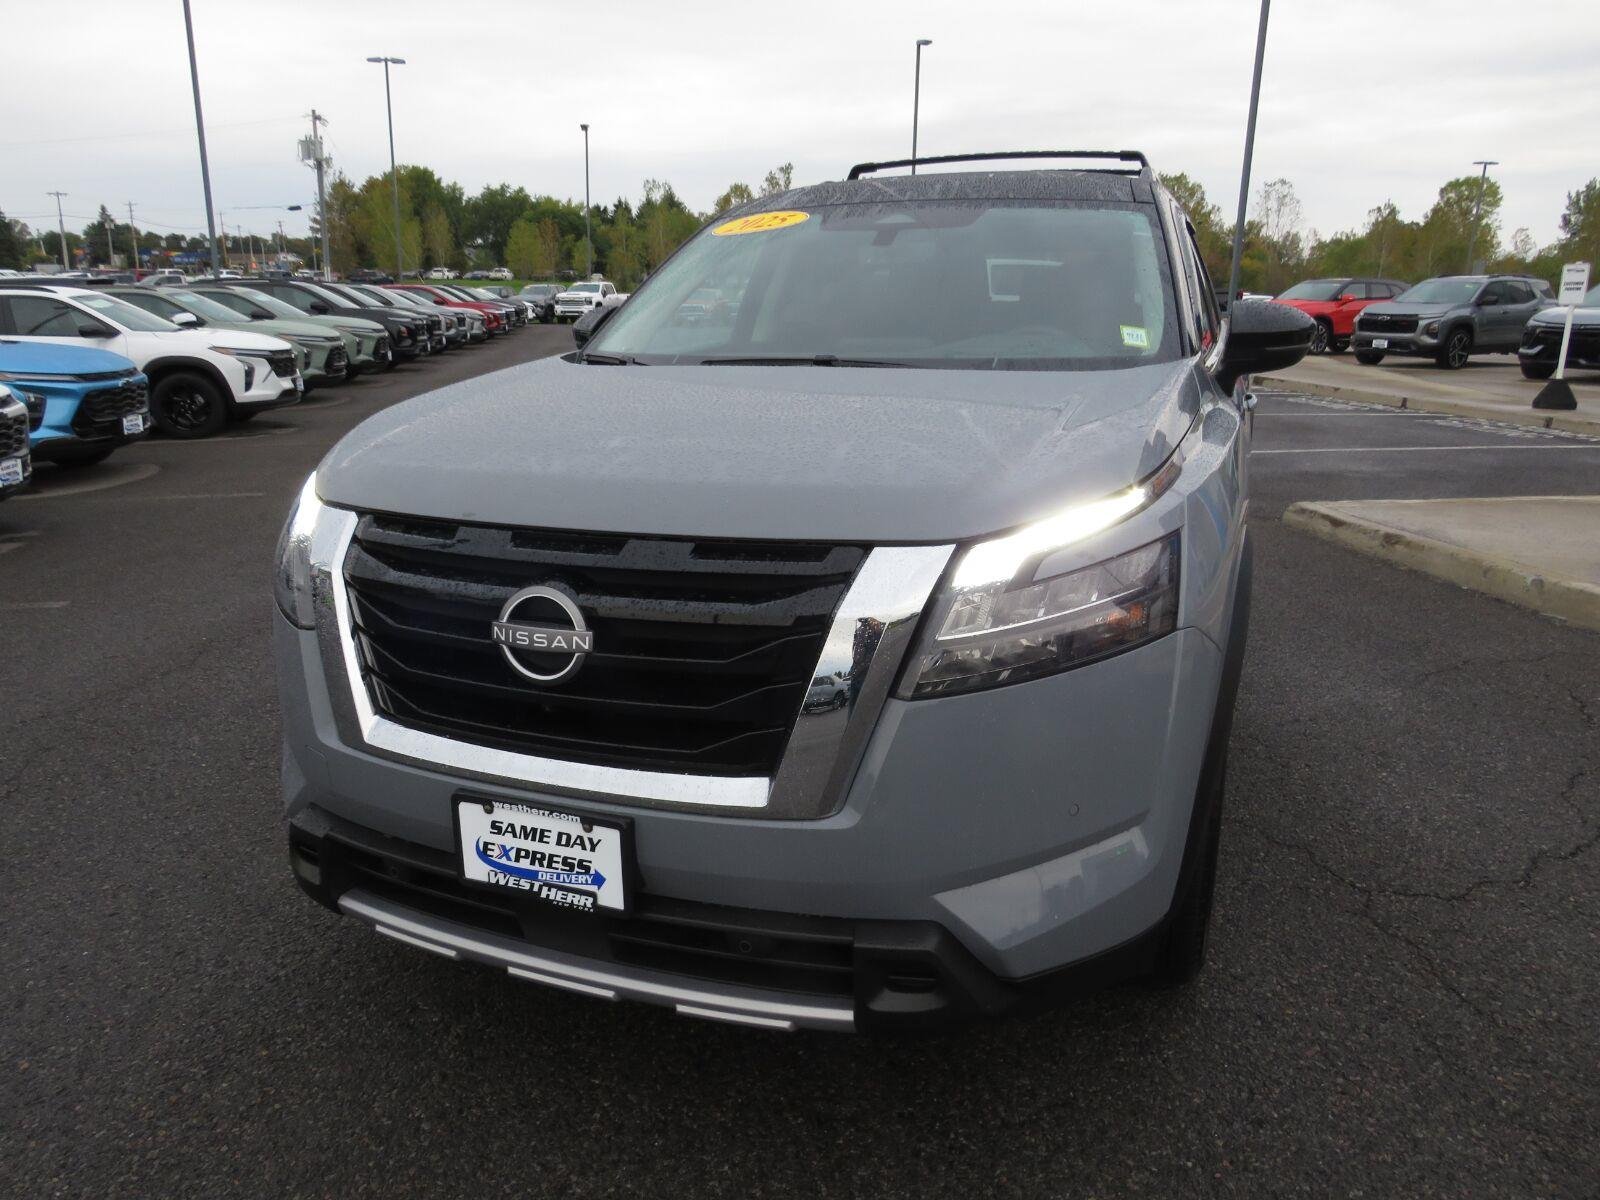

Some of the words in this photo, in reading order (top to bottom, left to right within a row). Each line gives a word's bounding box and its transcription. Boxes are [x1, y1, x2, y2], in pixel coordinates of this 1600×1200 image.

[493, 626, 589, 650] NISSAN
[493, 801, 581, 823] westherr.com
[489, 819, 552, 844] SAME
[555, 831, 602, 852] DAY
[482, 841, 593, 874] EXPRESS
[538, 871, 594, 885] DELIVERY
